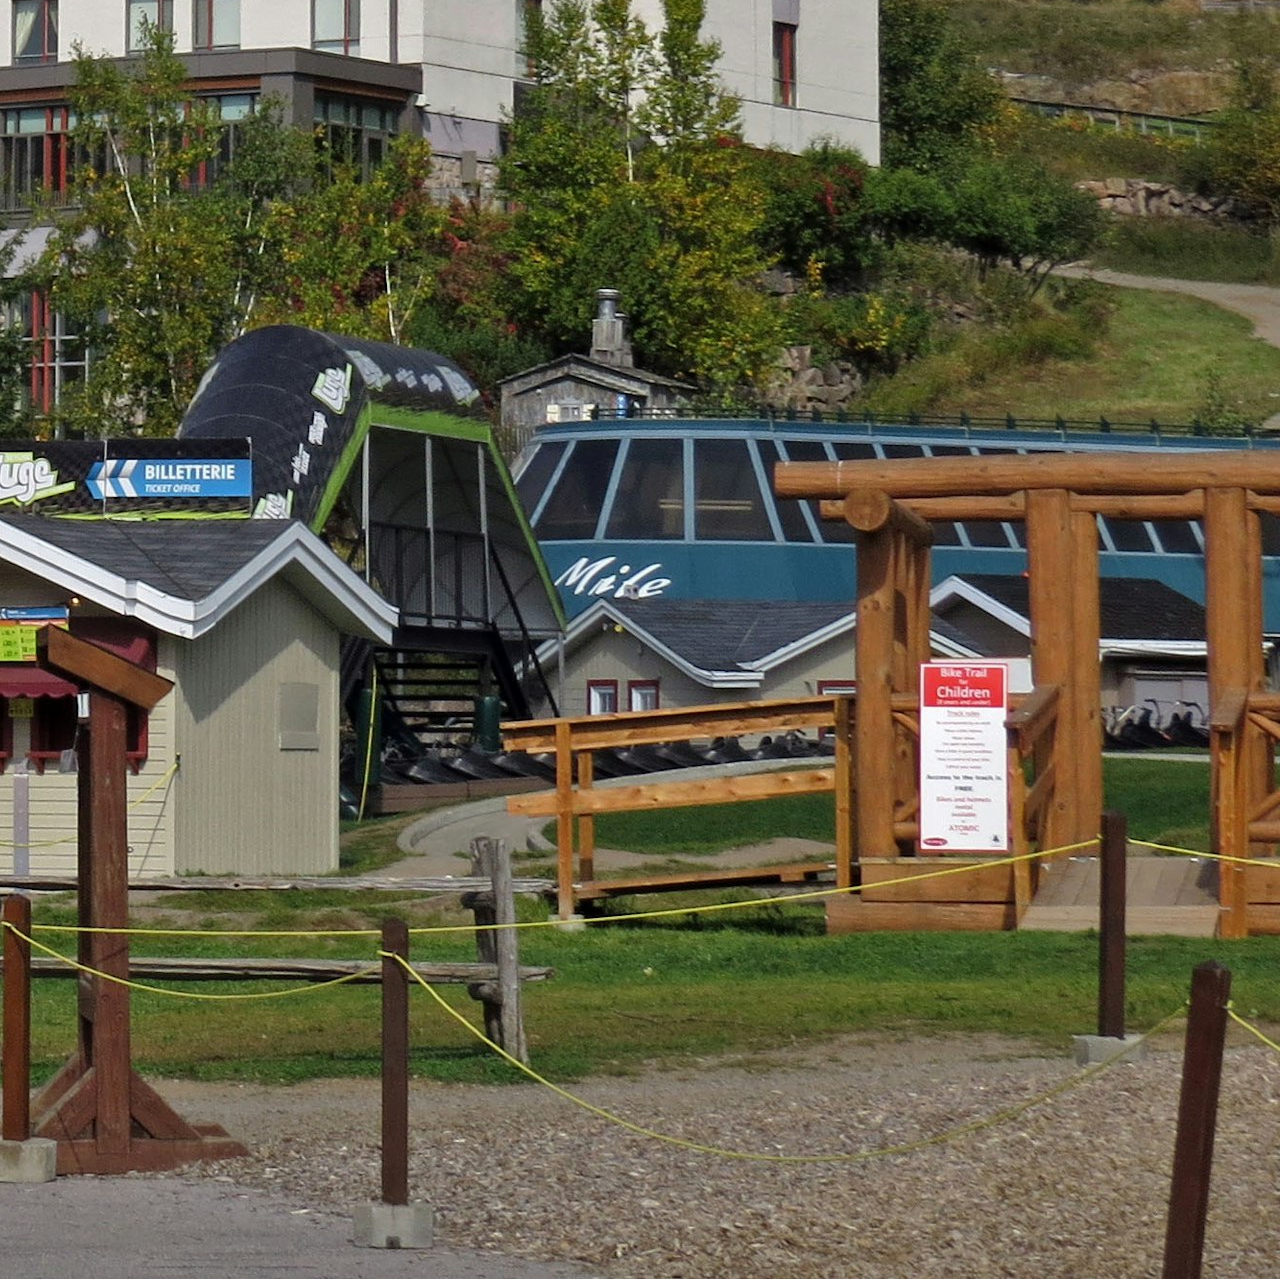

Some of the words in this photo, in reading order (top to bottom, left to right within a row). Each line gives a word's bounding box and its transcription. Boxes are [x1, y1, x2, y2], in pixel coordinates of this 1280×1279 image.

[144, 464, 236, 481] BILLETTERIE
[144, 483, 172, 494] TICKET
[173, 483, 201, 494] OFFICE
[940, 667, 963, 678] Bike
[965, 667, 987, 678] Trail
[936, 685, 991, 699] Children
[948, 825, 980, 833] ATOMIC
